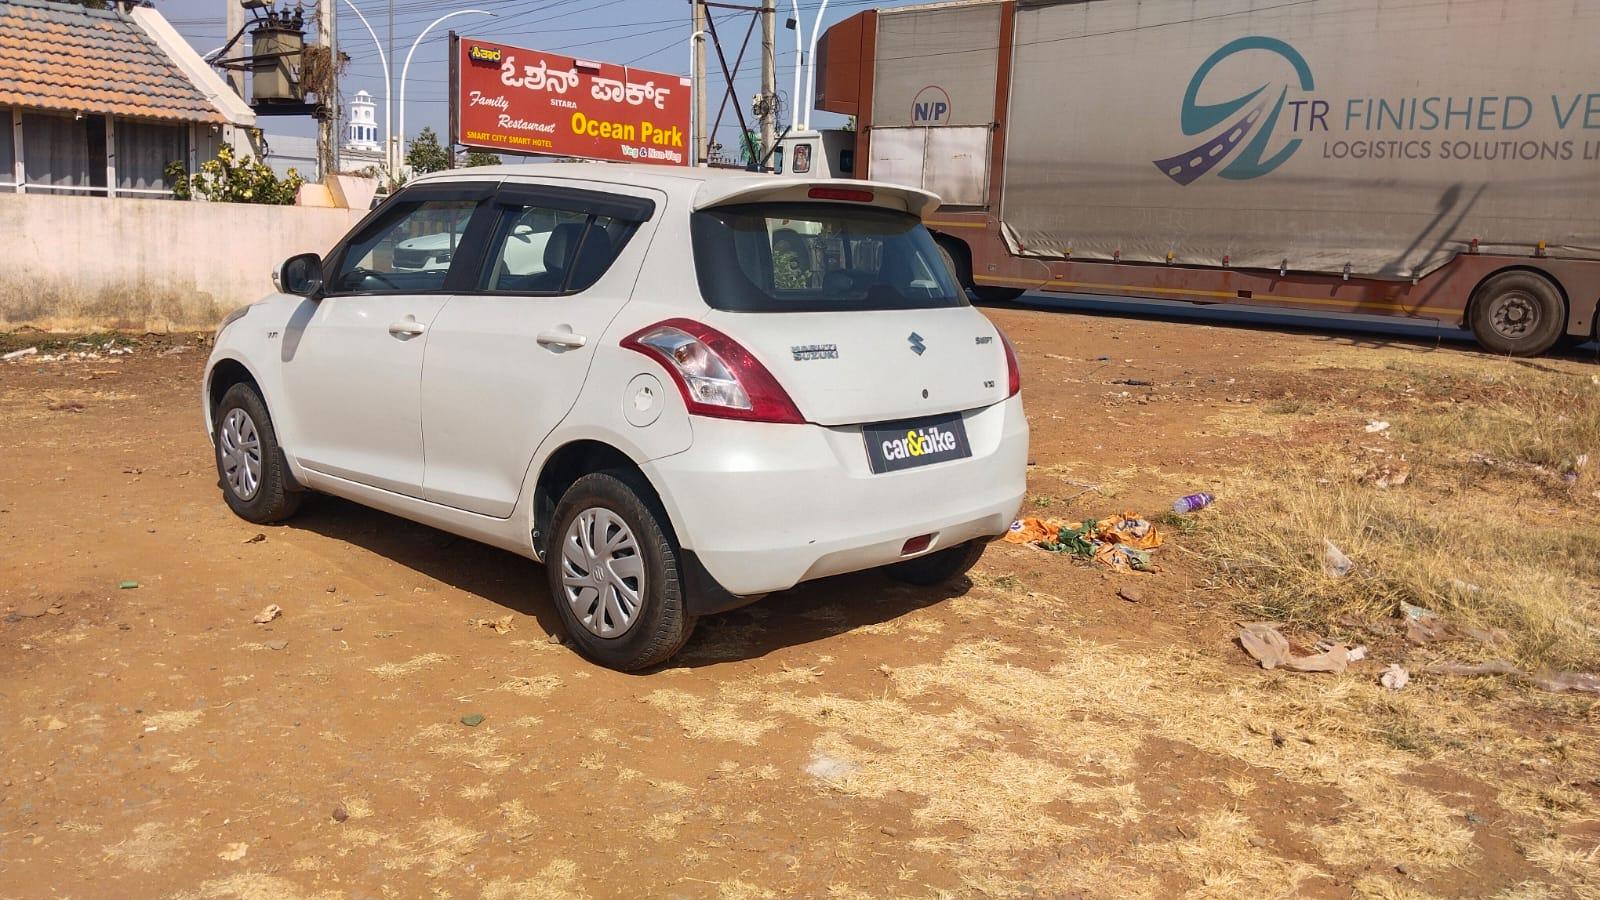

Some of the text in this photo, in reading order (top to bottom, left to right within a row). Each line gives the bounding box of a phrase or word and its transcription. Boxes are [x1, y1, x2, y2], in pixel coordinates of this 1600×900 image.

[469, 90, 509, 111] Family
[591, 76, 670, 109] ಪಾರ್ಕ್
[550, 98, 577, 109] SITARA
[914, 101, 947, 121] N/P
[498, 114, 556, 133] Restaurant
[1288, 100, 1330, 132] TR
[1345, 96, 1533, 131] FINISHED
[466, 131, 553, 148] SMART CITY SMART HOTEL
[571, 112, 683, 147] Ocean Park
[621, 144, 682, 163] Veg & Non-Veg
[1323, 140, 1432, 159] LOGISTICS
[1439, 140, 1574, 160] SOLUTIONS
[793, 350, 839, 361] SUZUKI
[882, 427, 956, 460] car&bike
